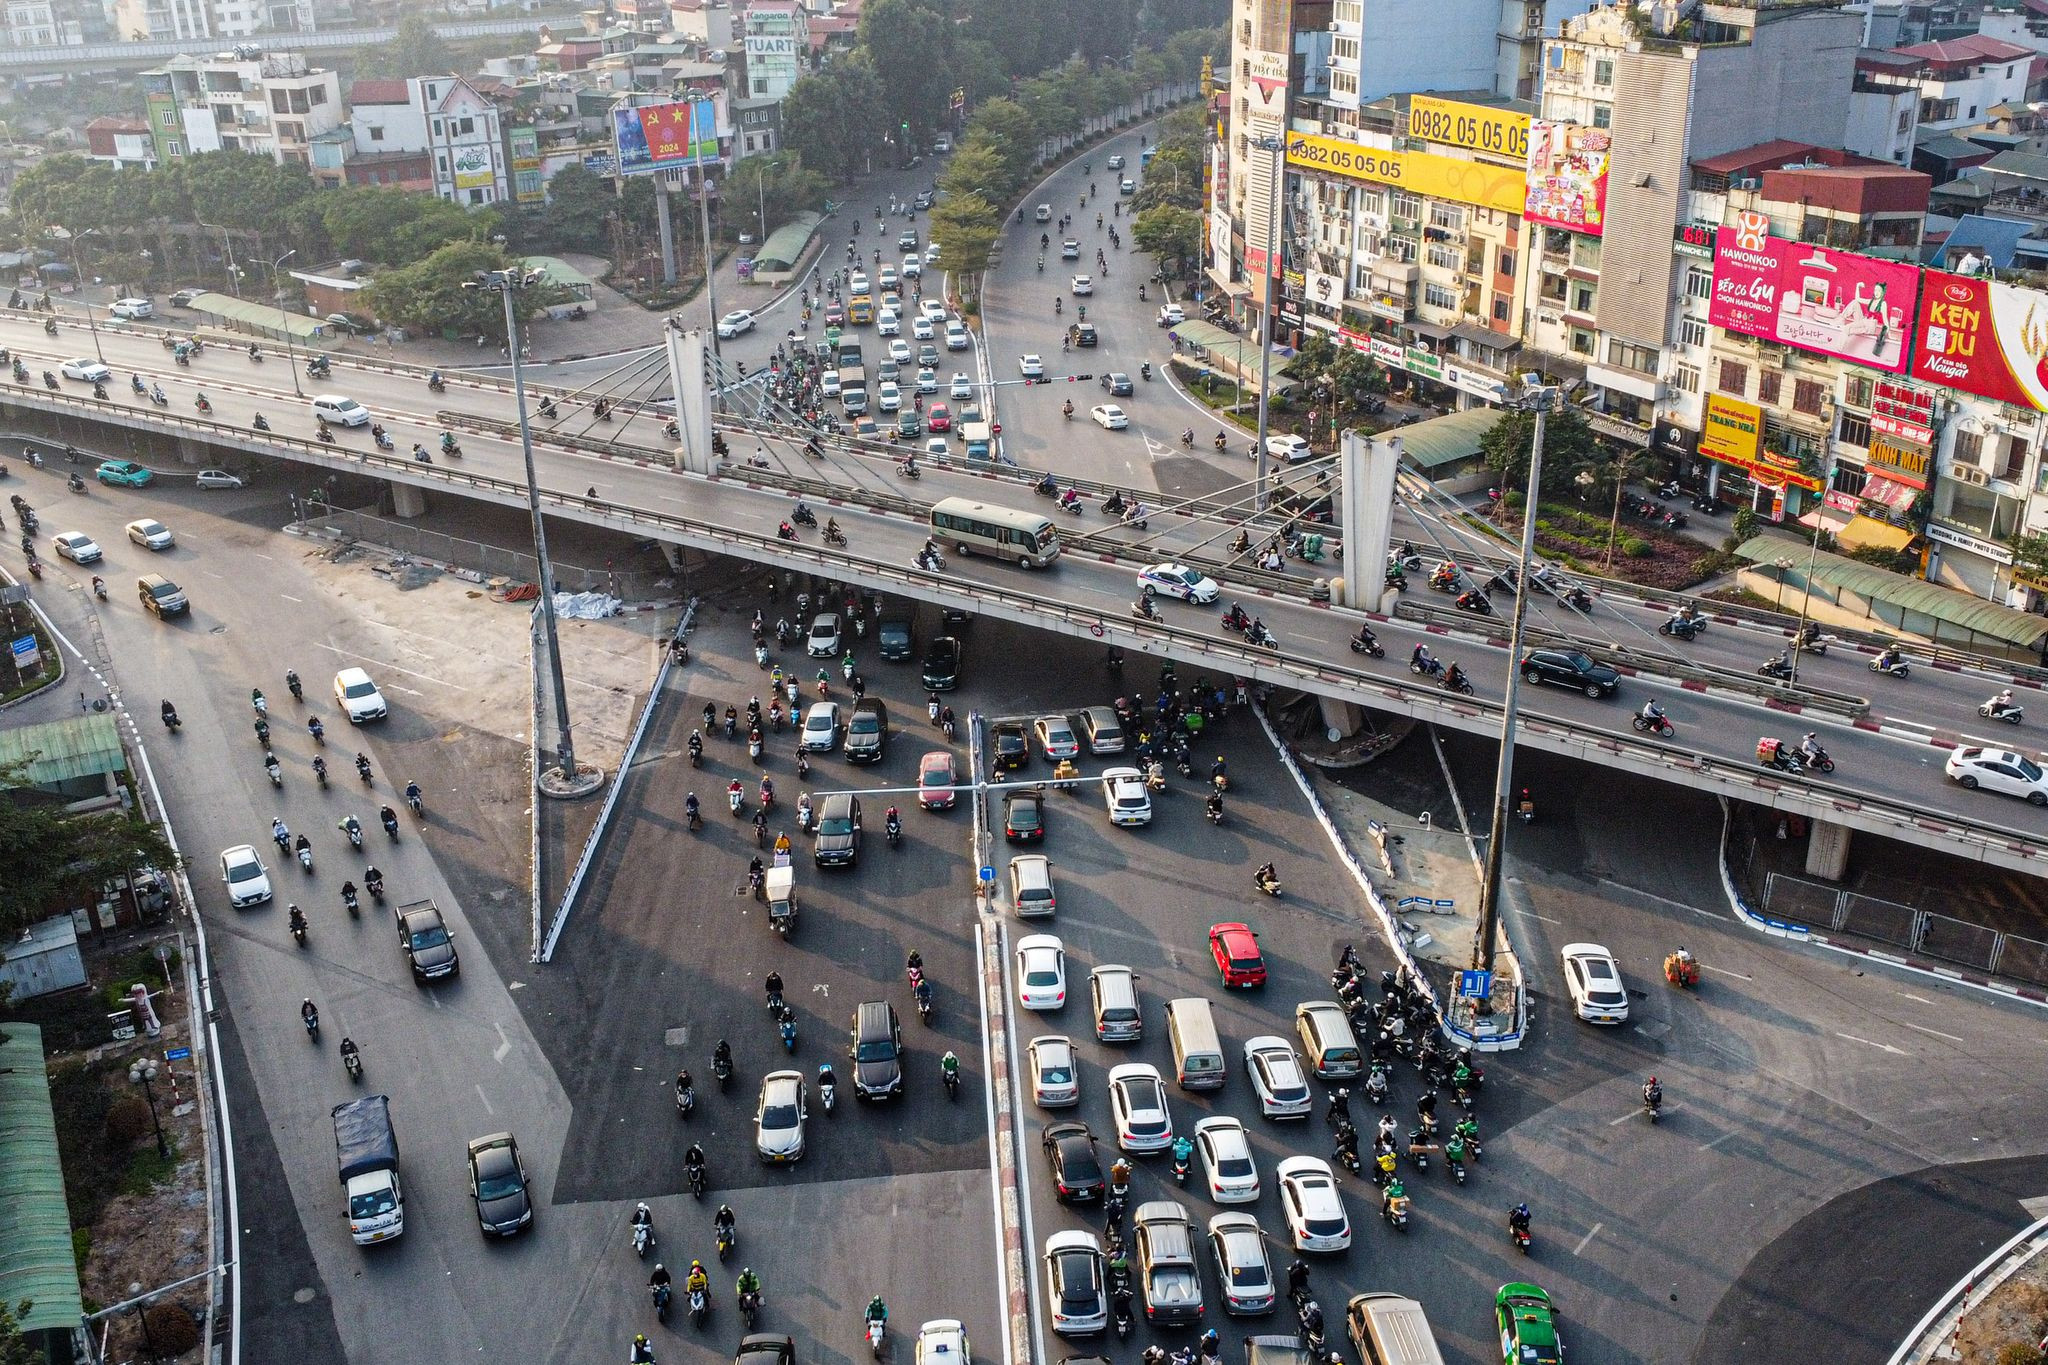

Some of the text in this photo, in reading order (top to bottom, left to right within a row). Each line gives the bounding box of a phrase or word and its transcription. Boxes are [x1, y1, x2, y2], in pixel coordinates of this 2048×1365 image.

[746, 11, 788, 20] Kangaroo
[745, 39, 793, 52] TUART
[1412, 108, 1528, 155] 0982 05 05 05
[659, 144, 678, 153] 2024
[1330, 149, 1351, 168] 05
[1354, 155, 1375, 173] 05
[1379, 160, 1401, 178] 05
[1720, 247, 1778, 268] HAWONKOO
[1717, 278, 1735, 294] BẾP
[1735, 298, 1772, 313] HAWONKOO
[1930, 300, 1980, 332] KEN
[1946, 330, 1976, 356] JU
[1923, 354, 1969, 378] Nougat
[1709, 413, 1737, 429] TRANG
[1974, 542, 1990, 553] PHOTO
